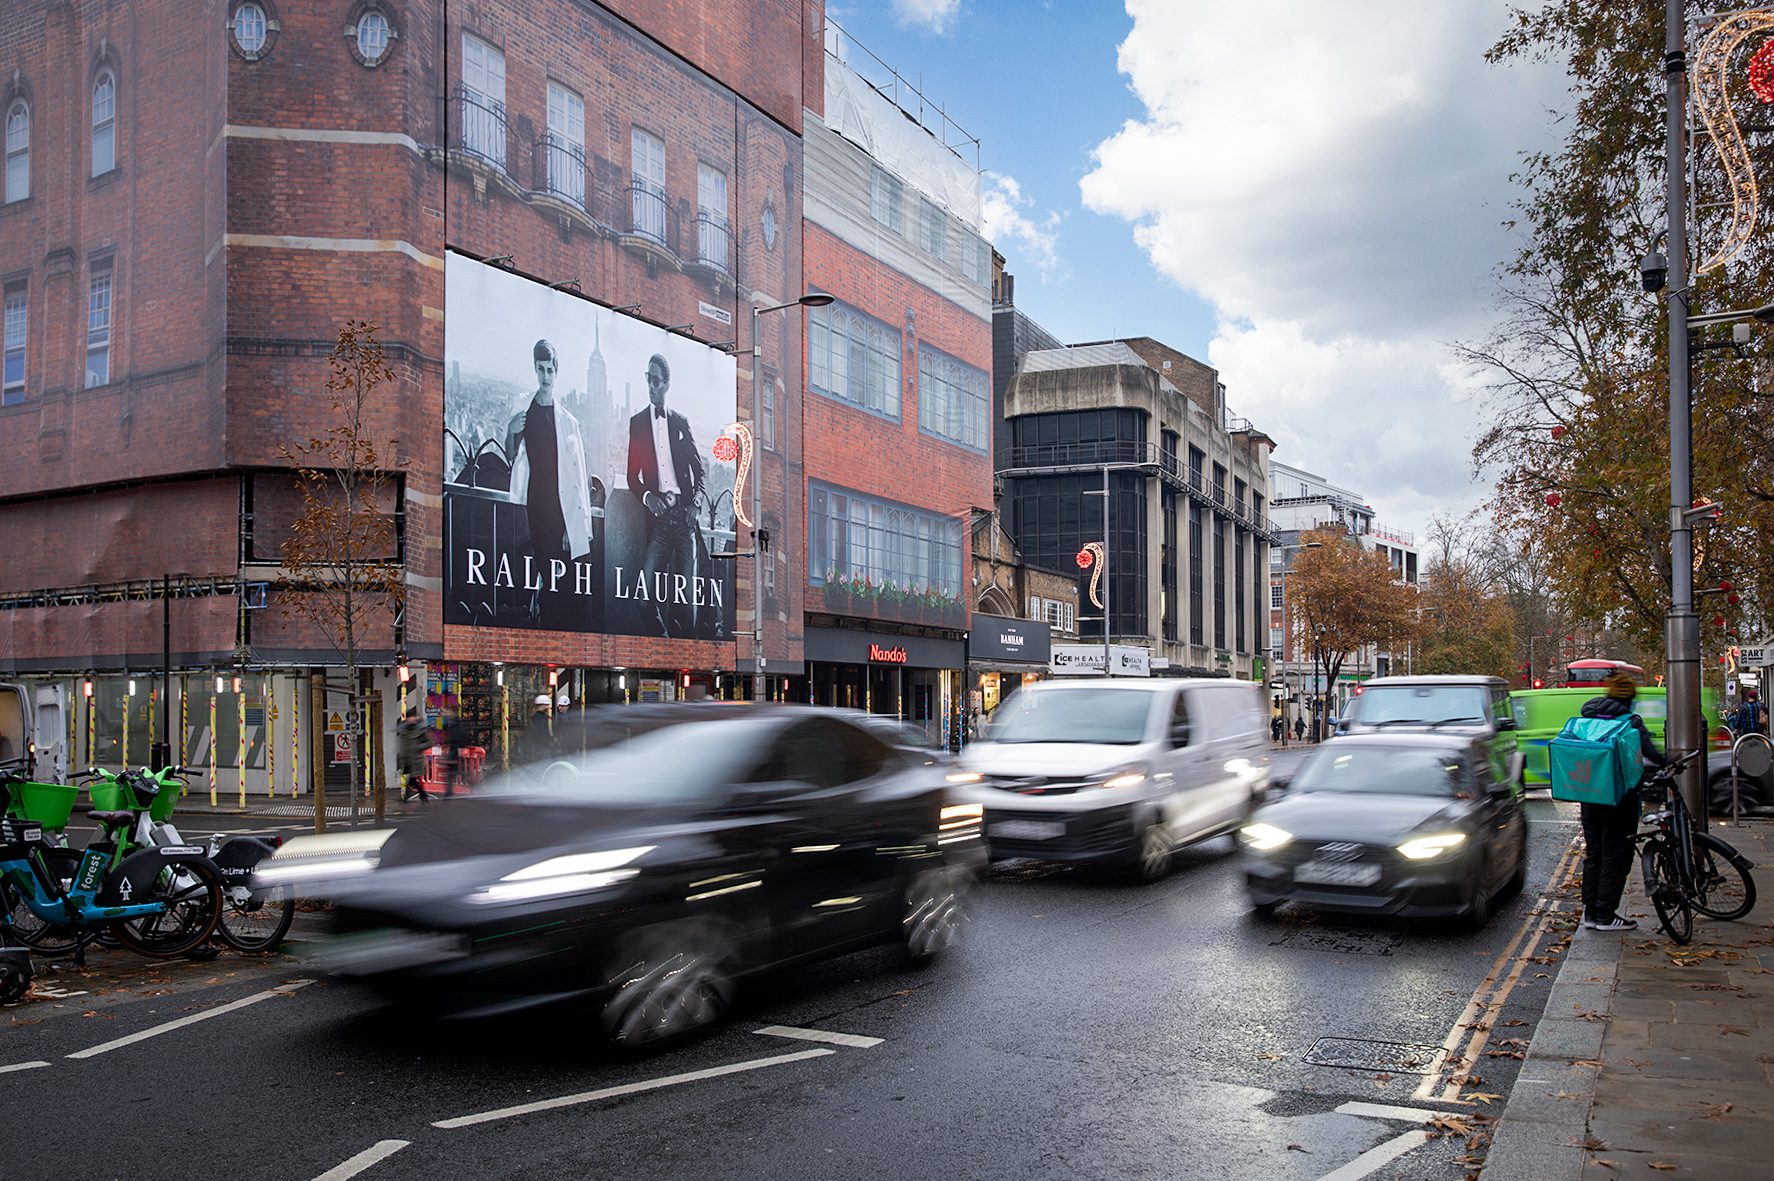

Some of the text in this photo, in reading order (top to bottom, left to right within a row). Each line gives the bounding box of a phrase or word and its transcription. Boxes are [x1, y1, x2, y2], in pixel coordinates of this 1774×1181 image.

[466, 548, 724, 608] RALPH LAUREN
[1000, 634, 1024, 646] BANHAM
[869, 644, 907, 663] Nando's
[81, 855, 101, 889] forest
[229, 867, 245, 876] Lime
